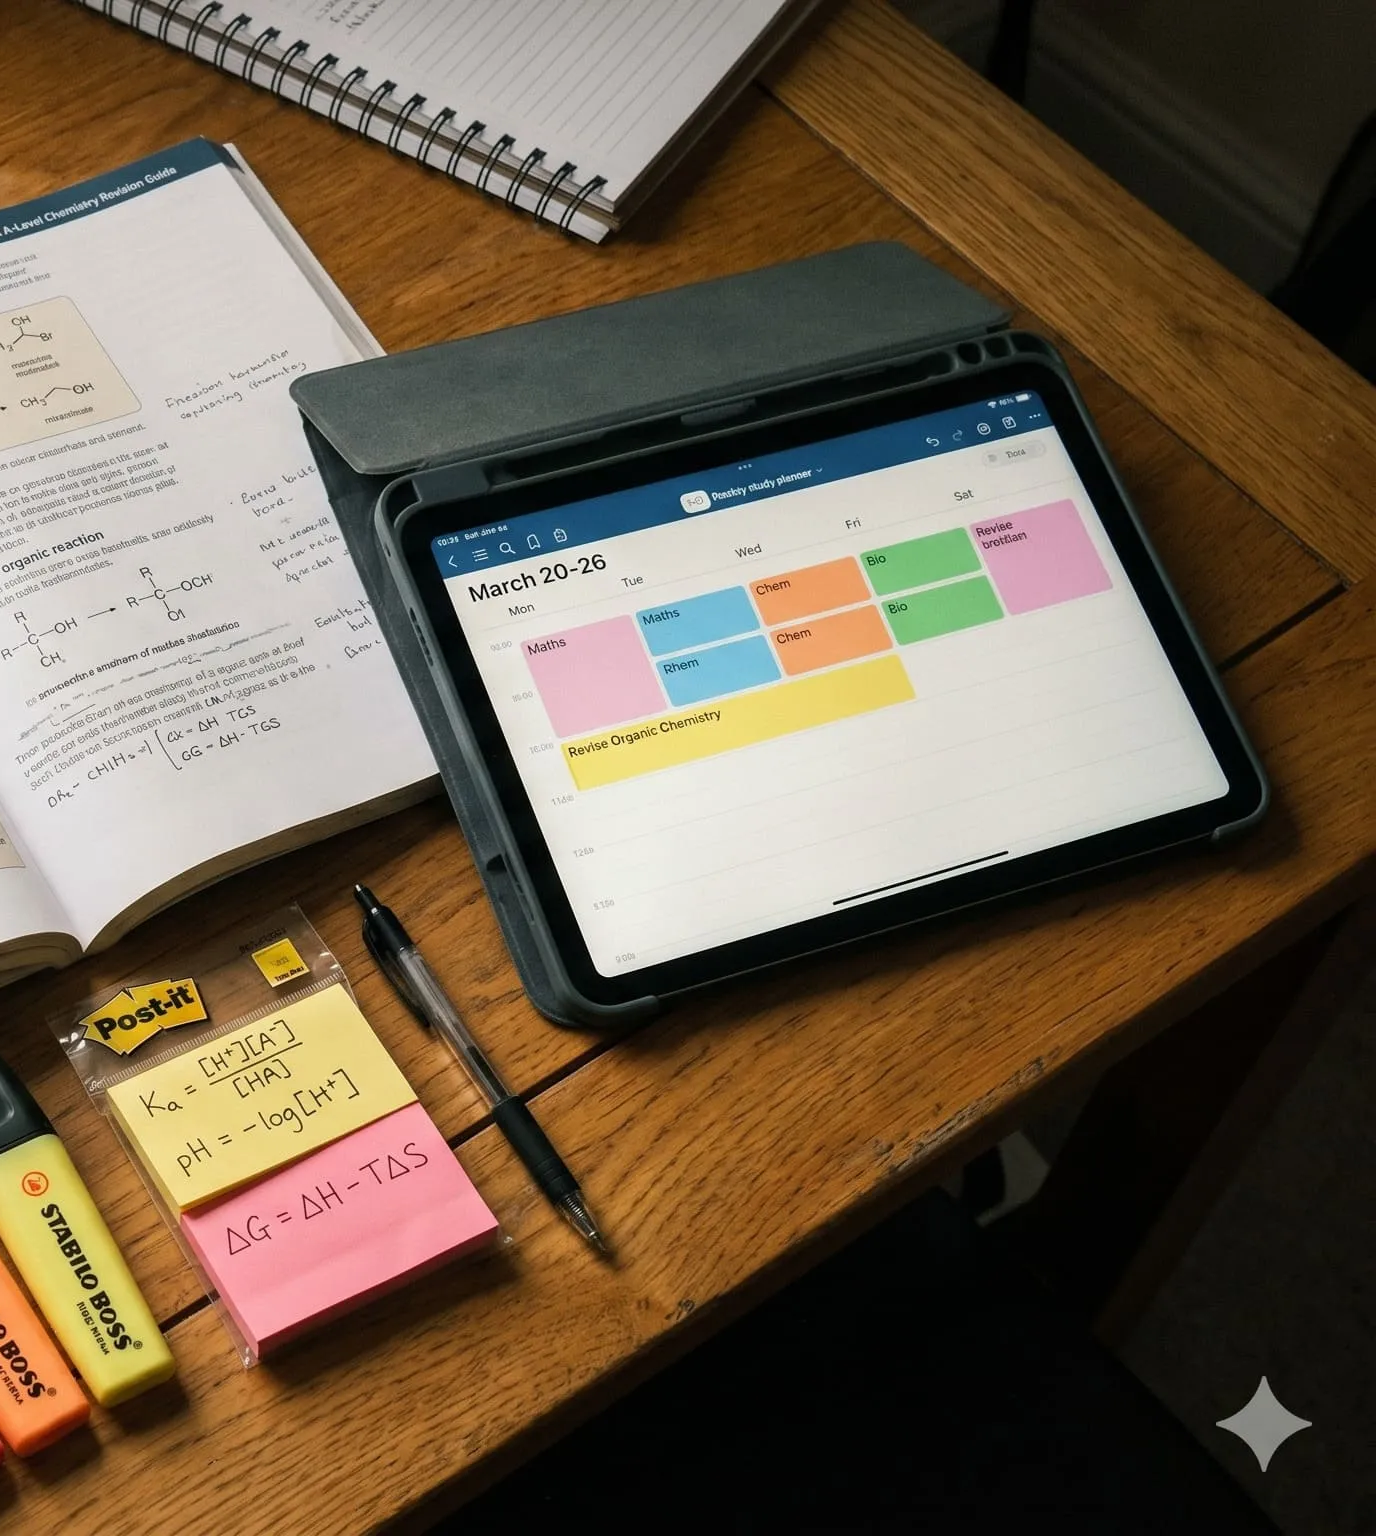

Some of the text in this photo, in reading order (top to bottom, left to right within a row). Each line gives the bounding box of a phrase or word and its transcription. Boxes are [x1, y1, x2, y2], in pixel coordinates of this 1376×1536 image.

[1, 546, 51, 575] organic
[51, 528, 106, 555] reaction
[508, 488, 975, 617] Mon Tue Wed Fri Sat
[865, 552, 887, 567] Bio
[138, 565, 154, 579] R
[467, 553, 608, 603] March 20-26
[755, 577, 792, 597] Chem
[125, 595, 140, 609] R
[153, 587, 166, 601] C
[887, 600, 909, 615] Bio
[13, 610, 27, 624] R
[642, 607, 681, 626] Maths
[26, 617, 79, 646] C OH
[776, 626, 812, 645] Chem
[0, 646, 14, 661] R
[526, 636, 568, 656] Maths
[662, 656, 700, 676] Rhem
[610, 725, 659, 748] Organic
[659, 707, 722, 734] Chemistry
[92, 984, 195, 1042] Post-it
[231, 1057, 292, 1099] [HA]
[185, 1083, 198, 1096] =
[176, 1137, 214, 1178] pH
[217, 1132, 233, 1147] =
[275, 1209, 293, 1225] =
[40, 1202, 100, 1292] STABILO
[90, 1288, 134, 1352] BOSS
